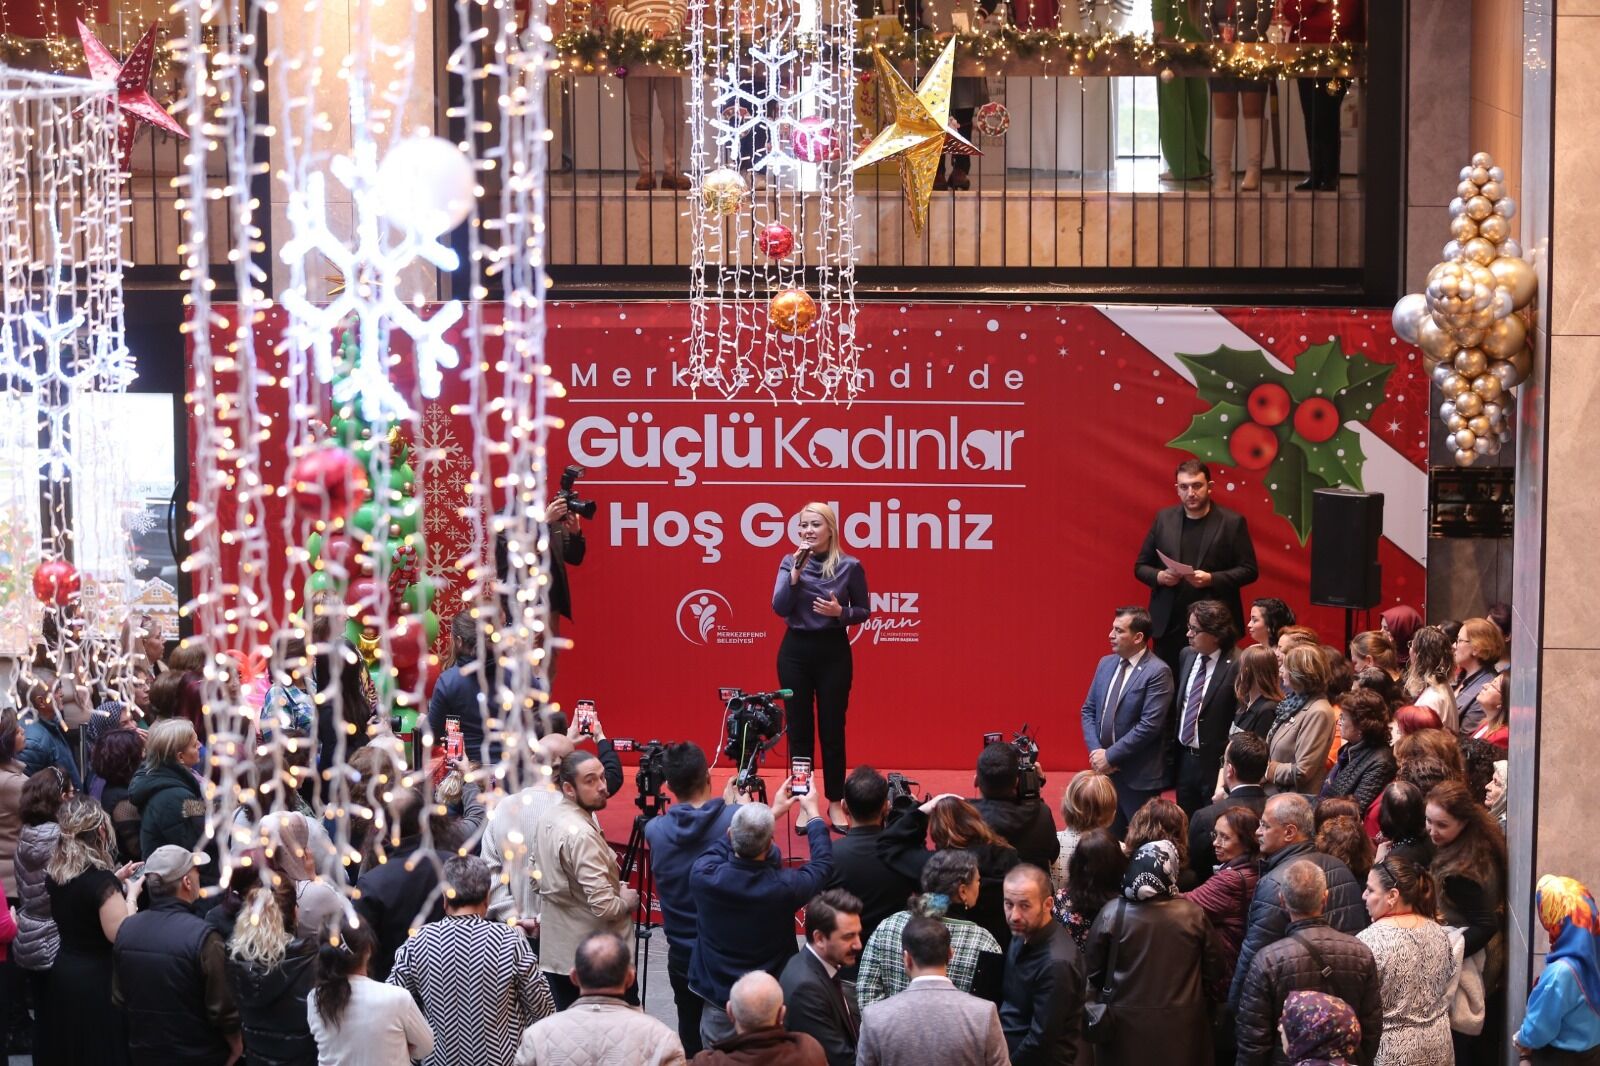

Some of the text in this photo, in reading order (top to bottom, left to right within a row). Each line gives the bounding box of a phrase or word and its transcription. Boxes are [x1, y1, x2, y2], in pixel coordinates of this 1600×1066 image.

[571, 362, 1024, 389] Merkezefendi'de
[567, 412, 1025, 487] Güçlü Kadınlar
[610, 501, 724, 563] Hoş
[867, 592, 919, 613] NİZ
